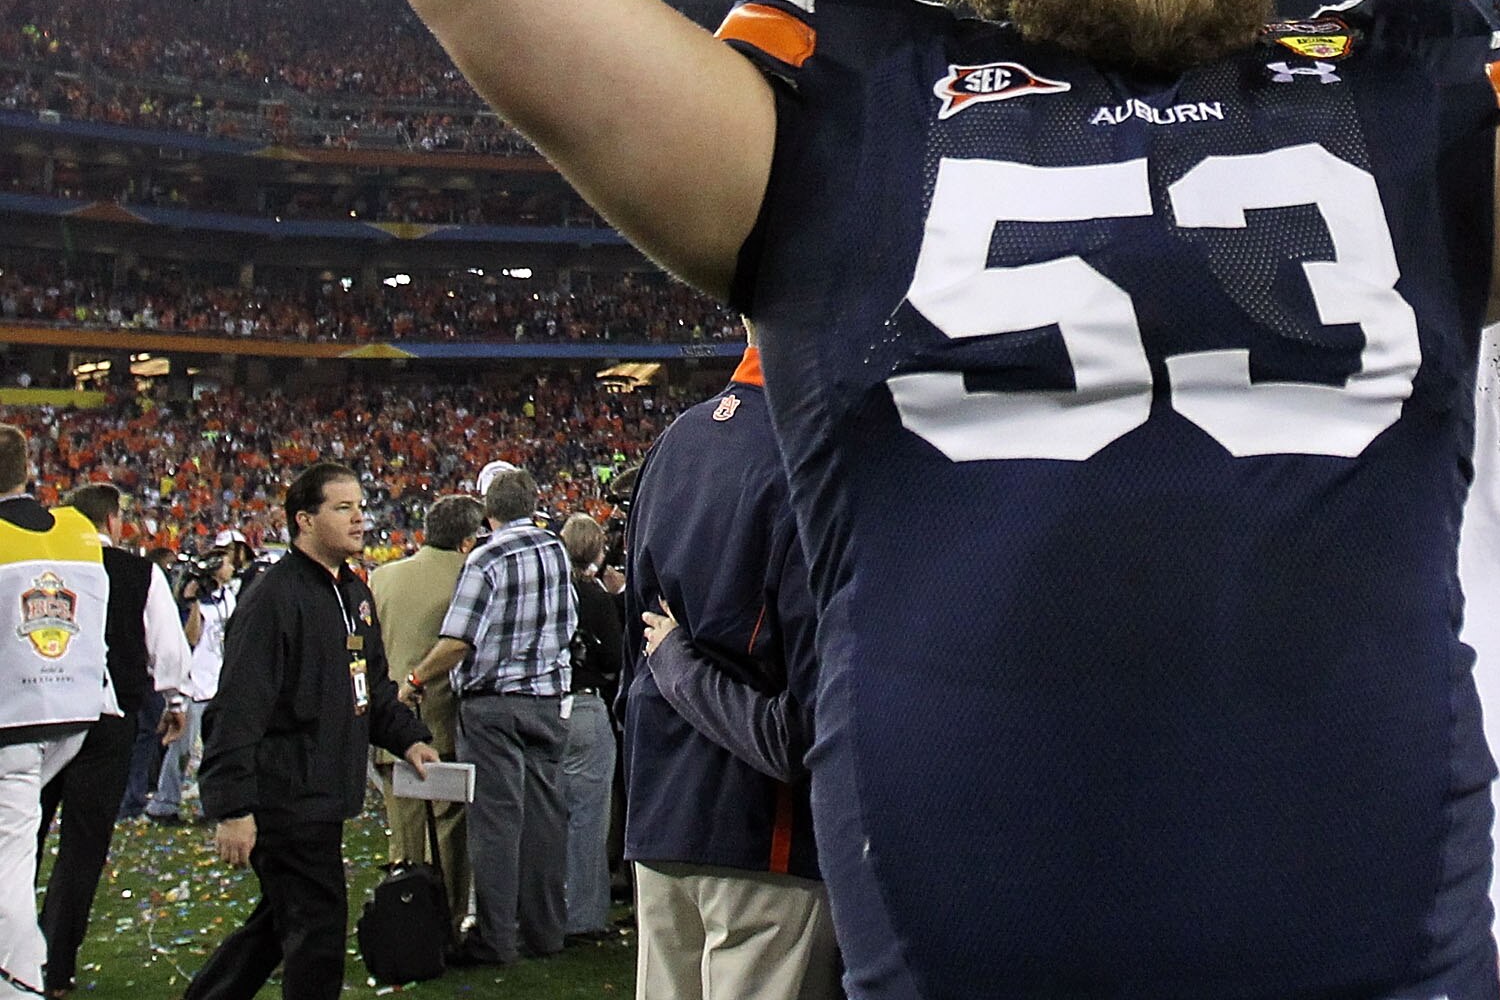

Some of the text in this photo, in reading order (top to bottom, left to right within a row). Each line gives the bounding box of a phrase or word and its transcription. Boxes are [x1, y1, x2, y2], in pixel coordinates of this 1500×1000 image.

[964, 67, 1012, 93] SEC
[1090, 98, 1225, 125] AUBURN
[886, 142, 1422, 462] 53
